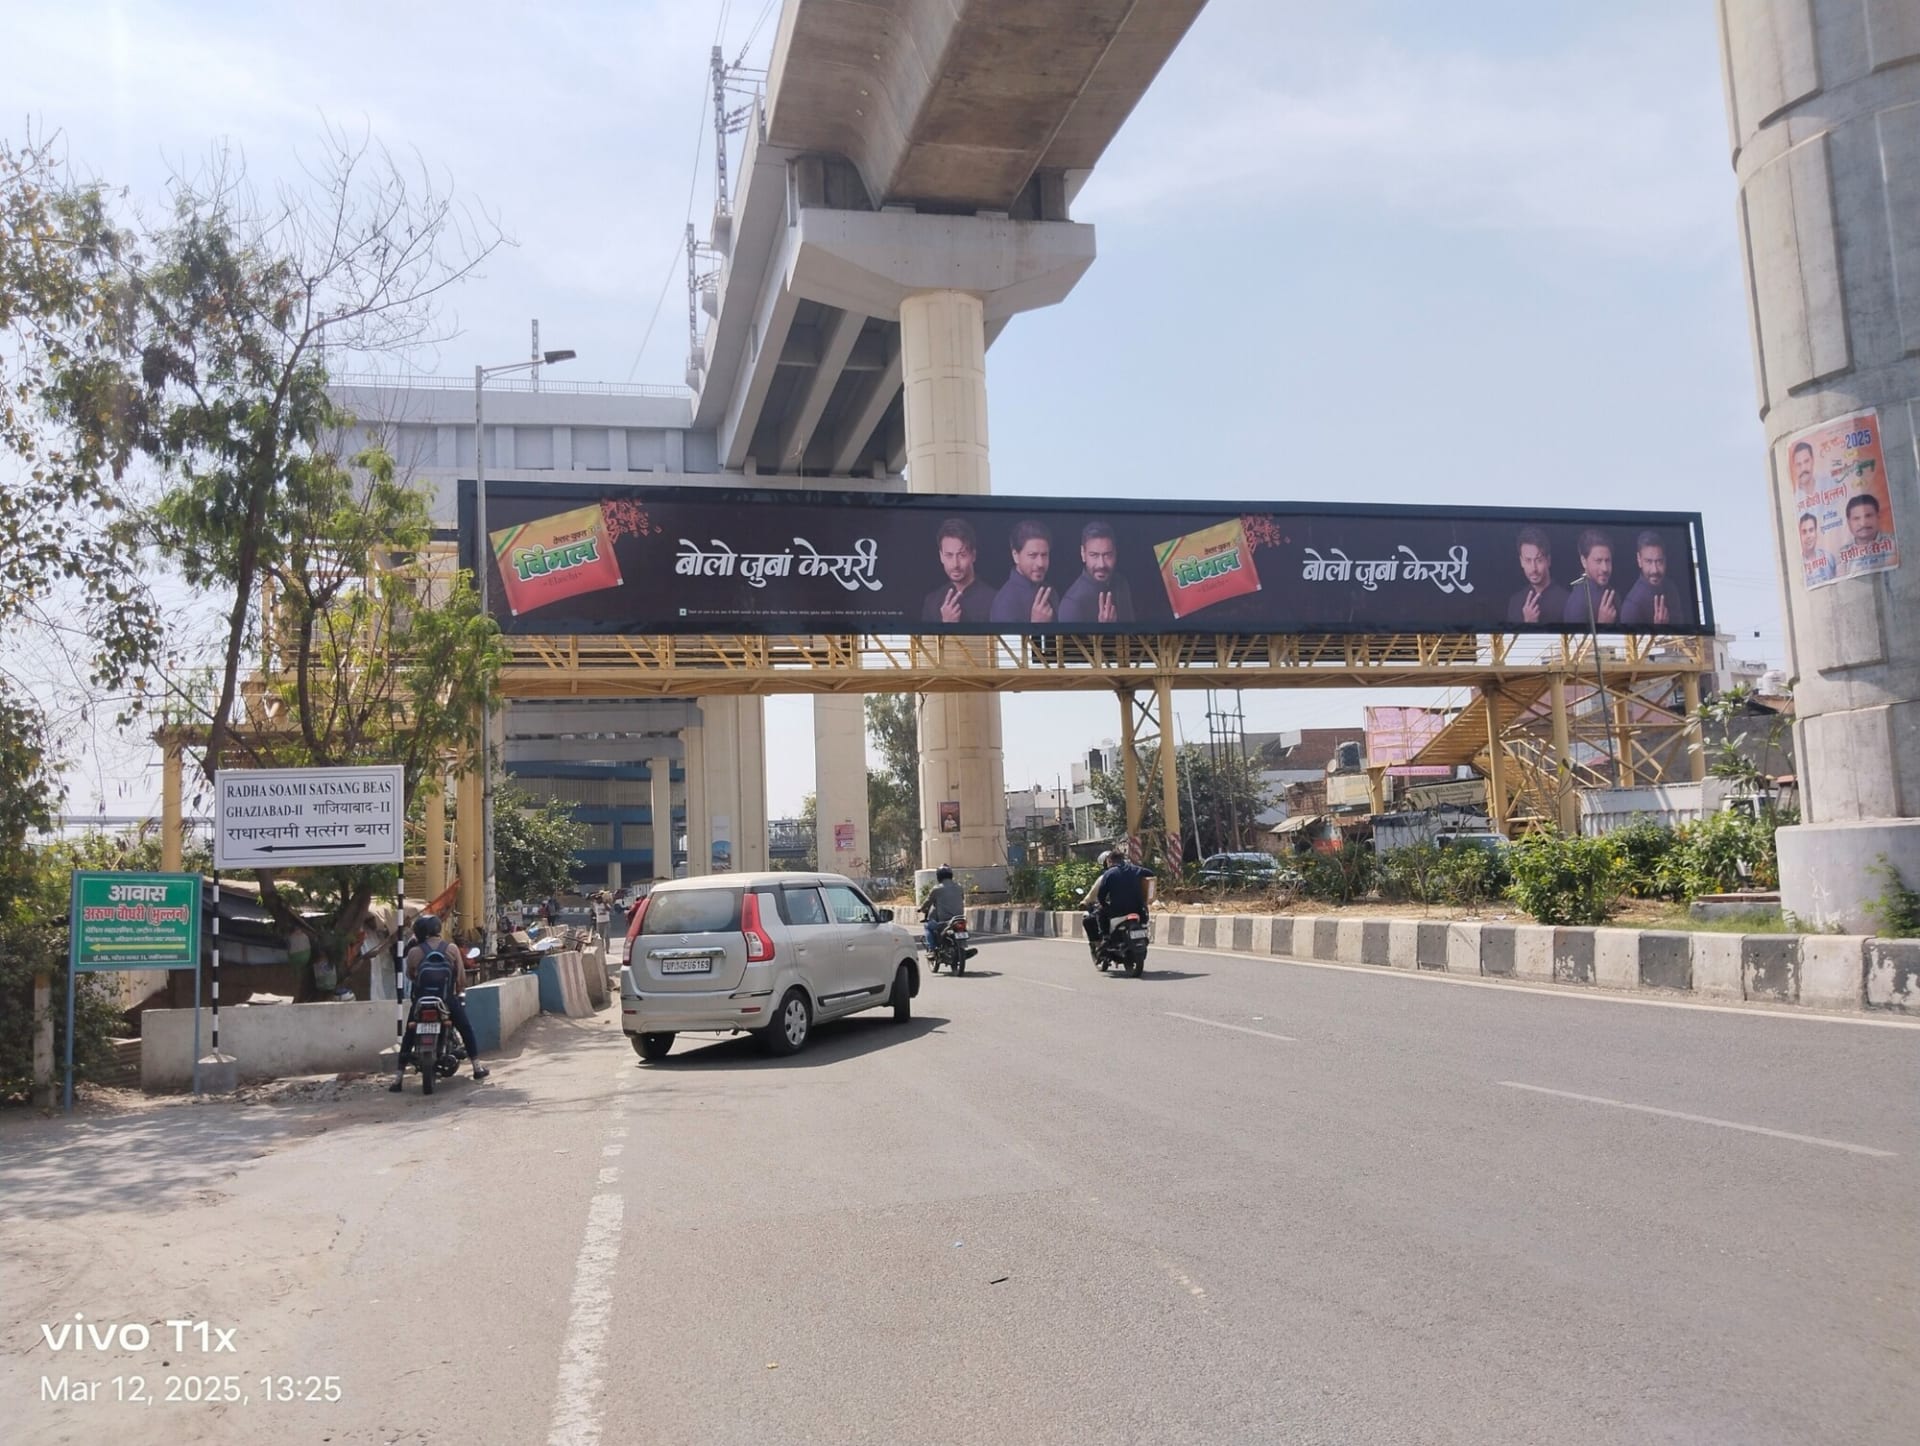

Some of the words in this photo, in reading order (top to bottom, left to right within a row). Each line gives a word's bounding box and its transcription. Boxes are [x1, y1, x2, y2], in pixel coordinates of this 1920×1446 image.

[1845, 429, 1872, 449] 2025
[675, 537, 739, 576] बोलो
[793, 537, 883, 591] केसरी
[1302, 547, 1352, 582] बोलो
[1398, 544, 1474, 594] केसरी
[227, 783, 266, 798] RADHA
[269, 782, 306, 797] SOAMI
[309, 781, 360, 796] SATSANG
[363, 780, 392, 794] BEAS
[226, 822, 299, 841] राधास्वामी
[305, 821, 349, 838] सत्संग
[354, 823, 391, 836] ब्यास
[108, 884, 168, 902] आवास
